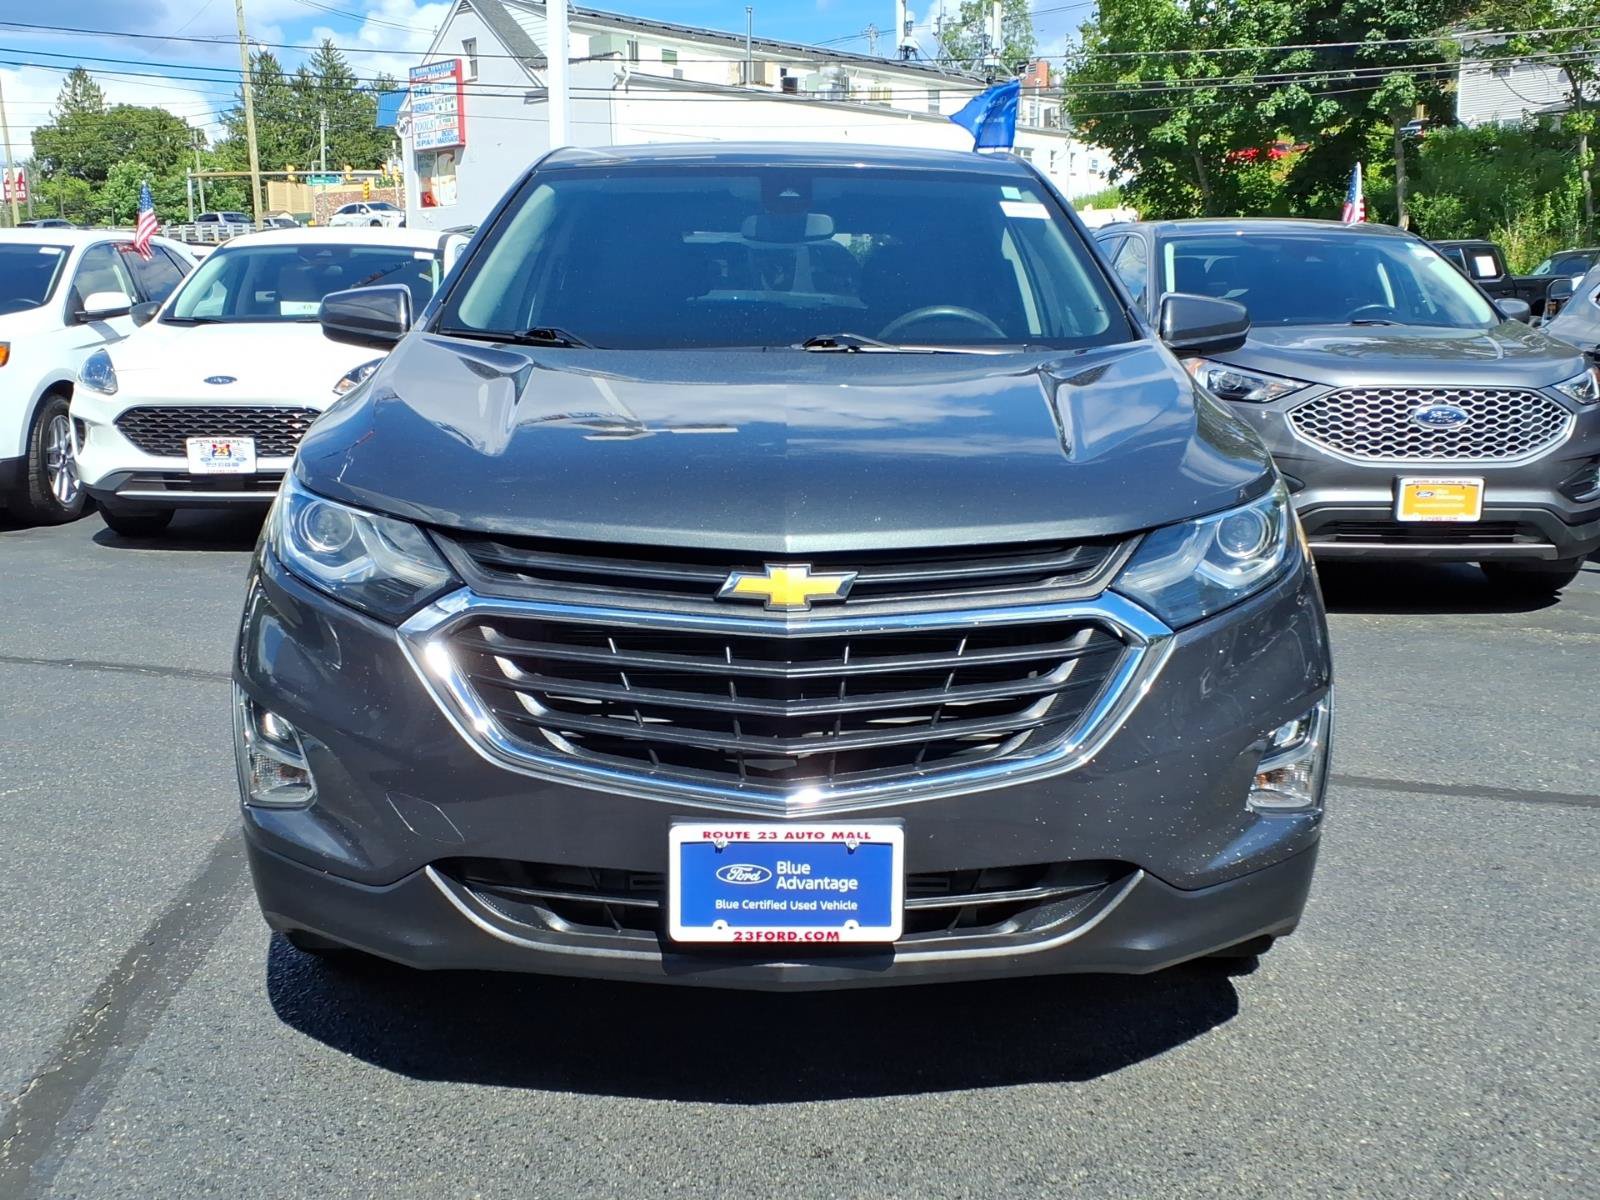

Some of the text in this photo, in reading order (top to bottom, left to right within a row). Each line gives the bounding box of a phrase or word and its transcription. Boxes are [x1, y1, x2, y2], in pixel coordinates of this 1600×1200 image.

[702, 831, 872, 840] ROUTE 23 AUTO MALL
[726, 865, 761, 882] Ford
[776, 861, 811, 875] Blue
[776, 876, 858, 893] Advantage
[715, 900, 858, 911] Blue Certified Used Vehicle
[733, 931, 840, 942] 23FORD.COM
